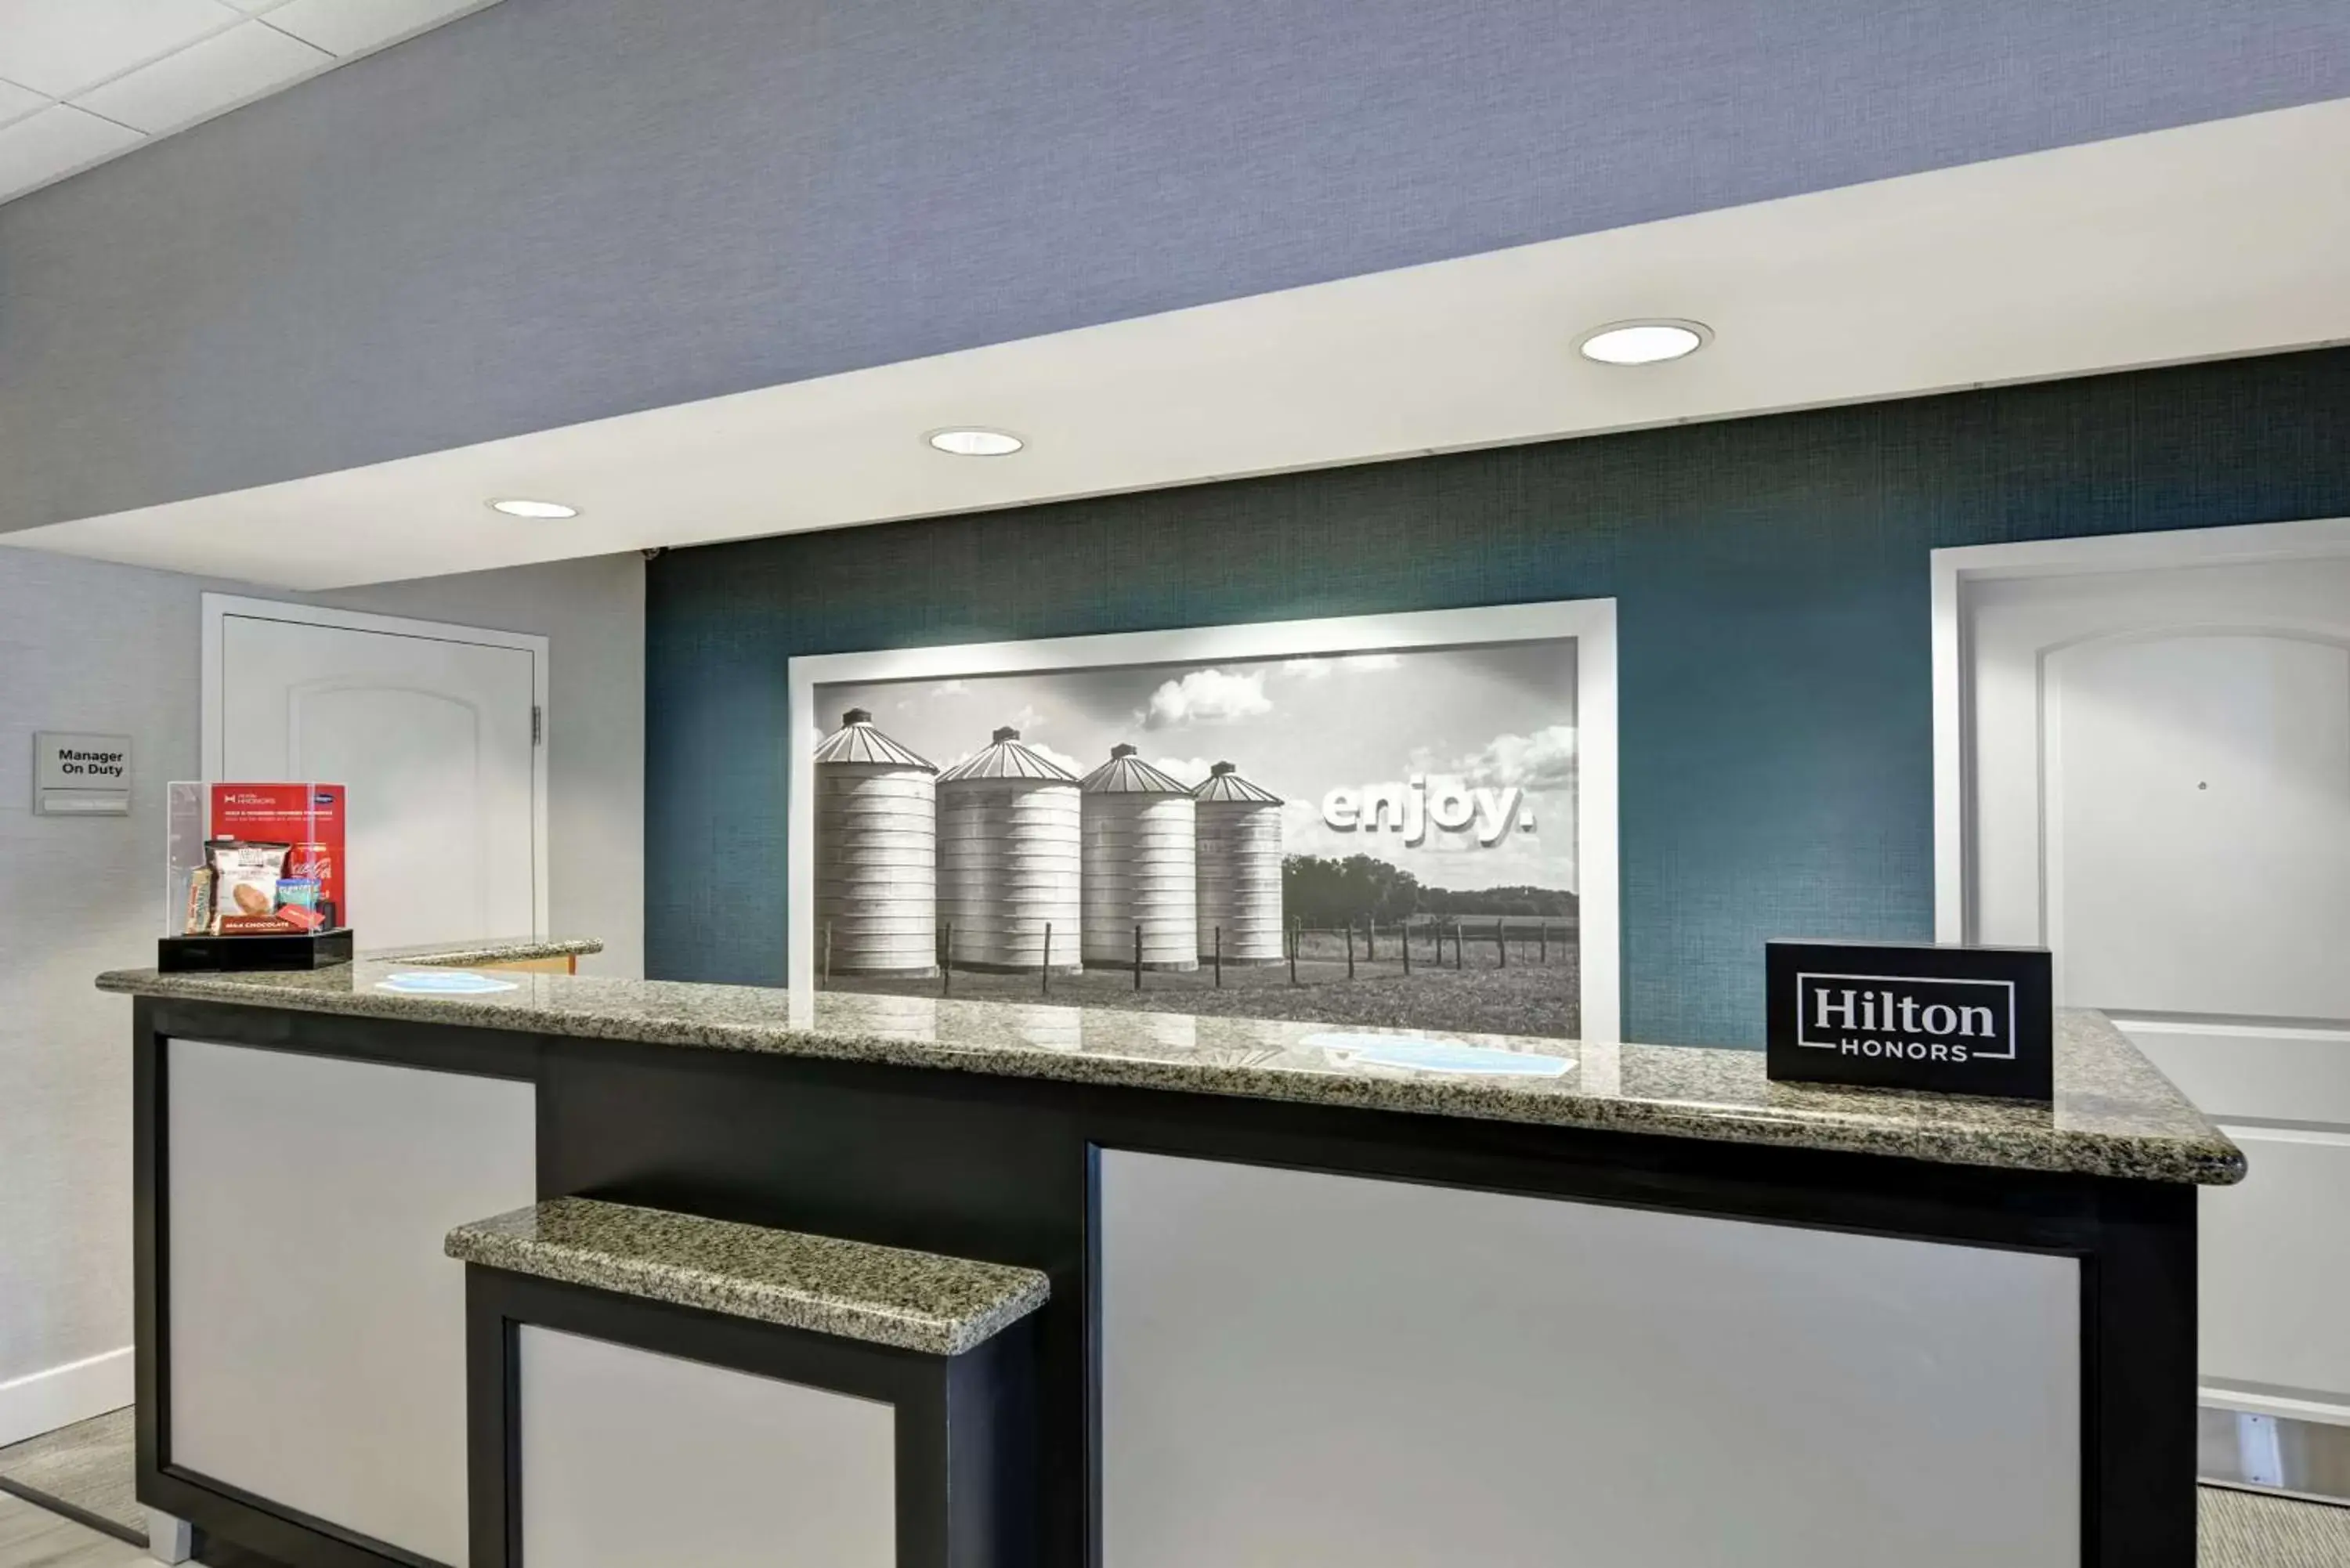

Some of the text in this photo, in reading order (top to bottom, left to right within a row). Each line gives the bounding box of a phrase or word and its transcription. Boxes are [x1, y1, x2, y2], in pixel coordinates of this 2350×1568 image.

[59, 750, 123, 763] Manager
[63, 763, 123, 777] On Duty
[1322, 772, 1537, 848] enjoy.
[1814, 988, 1996, 1038] Hilton
[1842, 1039, 1969, 1062] HONORS
